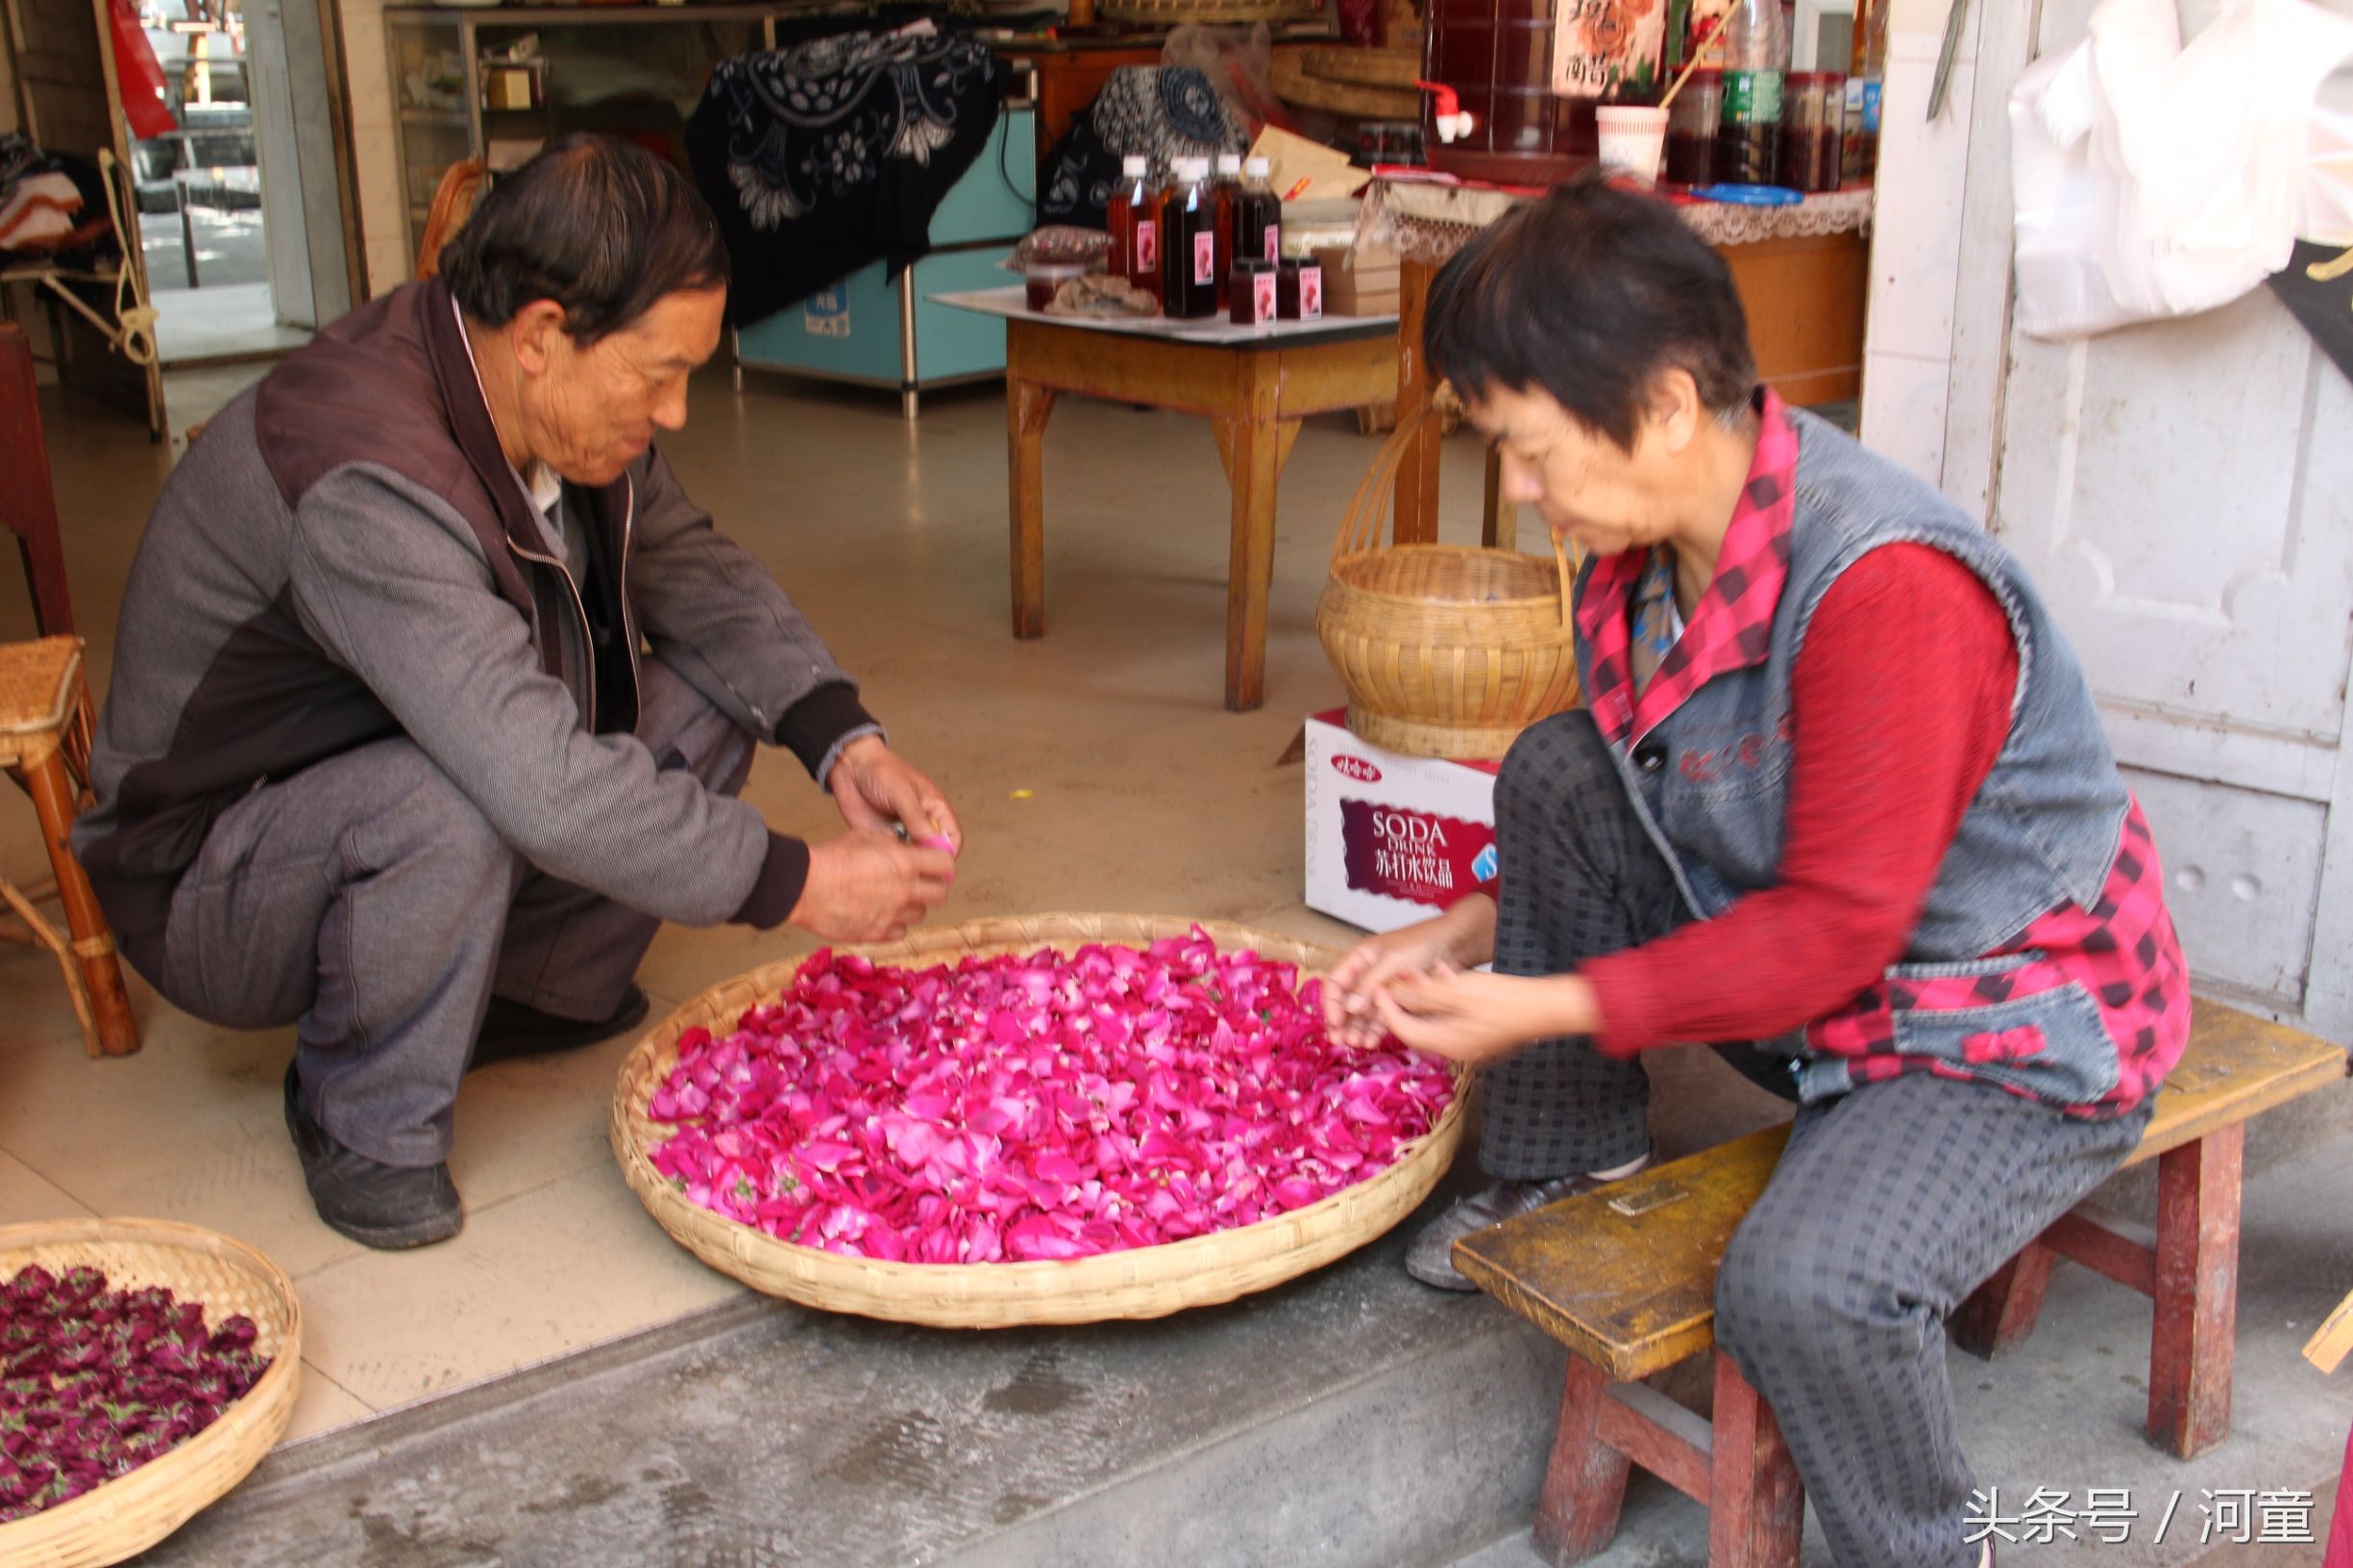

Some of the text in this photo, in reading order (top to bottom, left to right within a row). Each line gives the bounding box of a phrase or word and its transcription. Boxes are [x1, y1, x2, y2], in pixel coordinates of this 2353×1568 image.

[1373, 811, 1447, 846] SODA
[1387, 836, 1436, 858] DRINK
[1375, 848, 1453, 890] 苏打水饮品
